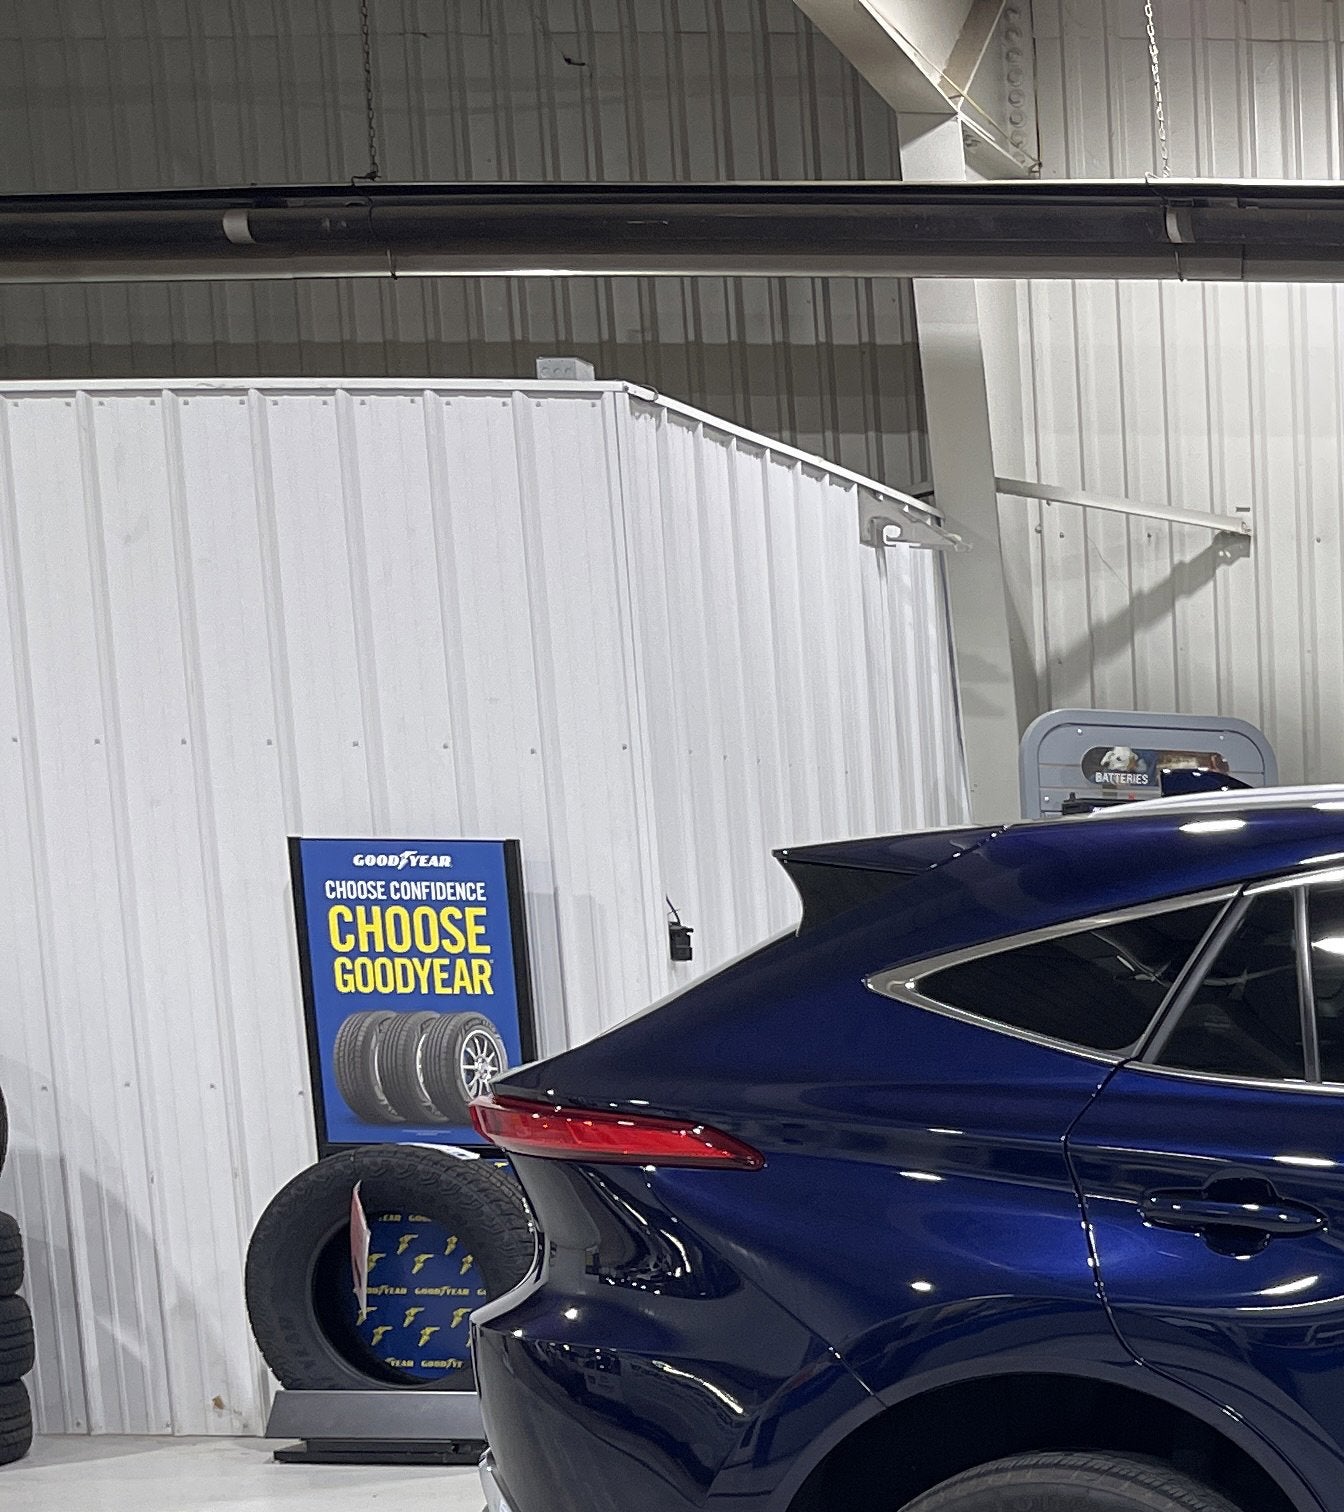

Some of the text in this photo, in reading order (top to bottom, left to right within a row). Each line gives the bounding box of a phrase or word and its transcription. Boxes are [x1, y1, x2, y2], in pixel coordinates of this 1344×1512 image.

[1095, 771, 1149, 785] BATTERIES
[352, 851, 453, 870] GOODYEAR
[325, 881, 487, 901] CHOOSE CONFIDENCE
[328, 904, 491, 954] CHOOSE
[333, 957, 494, 995] GOODYEAR
